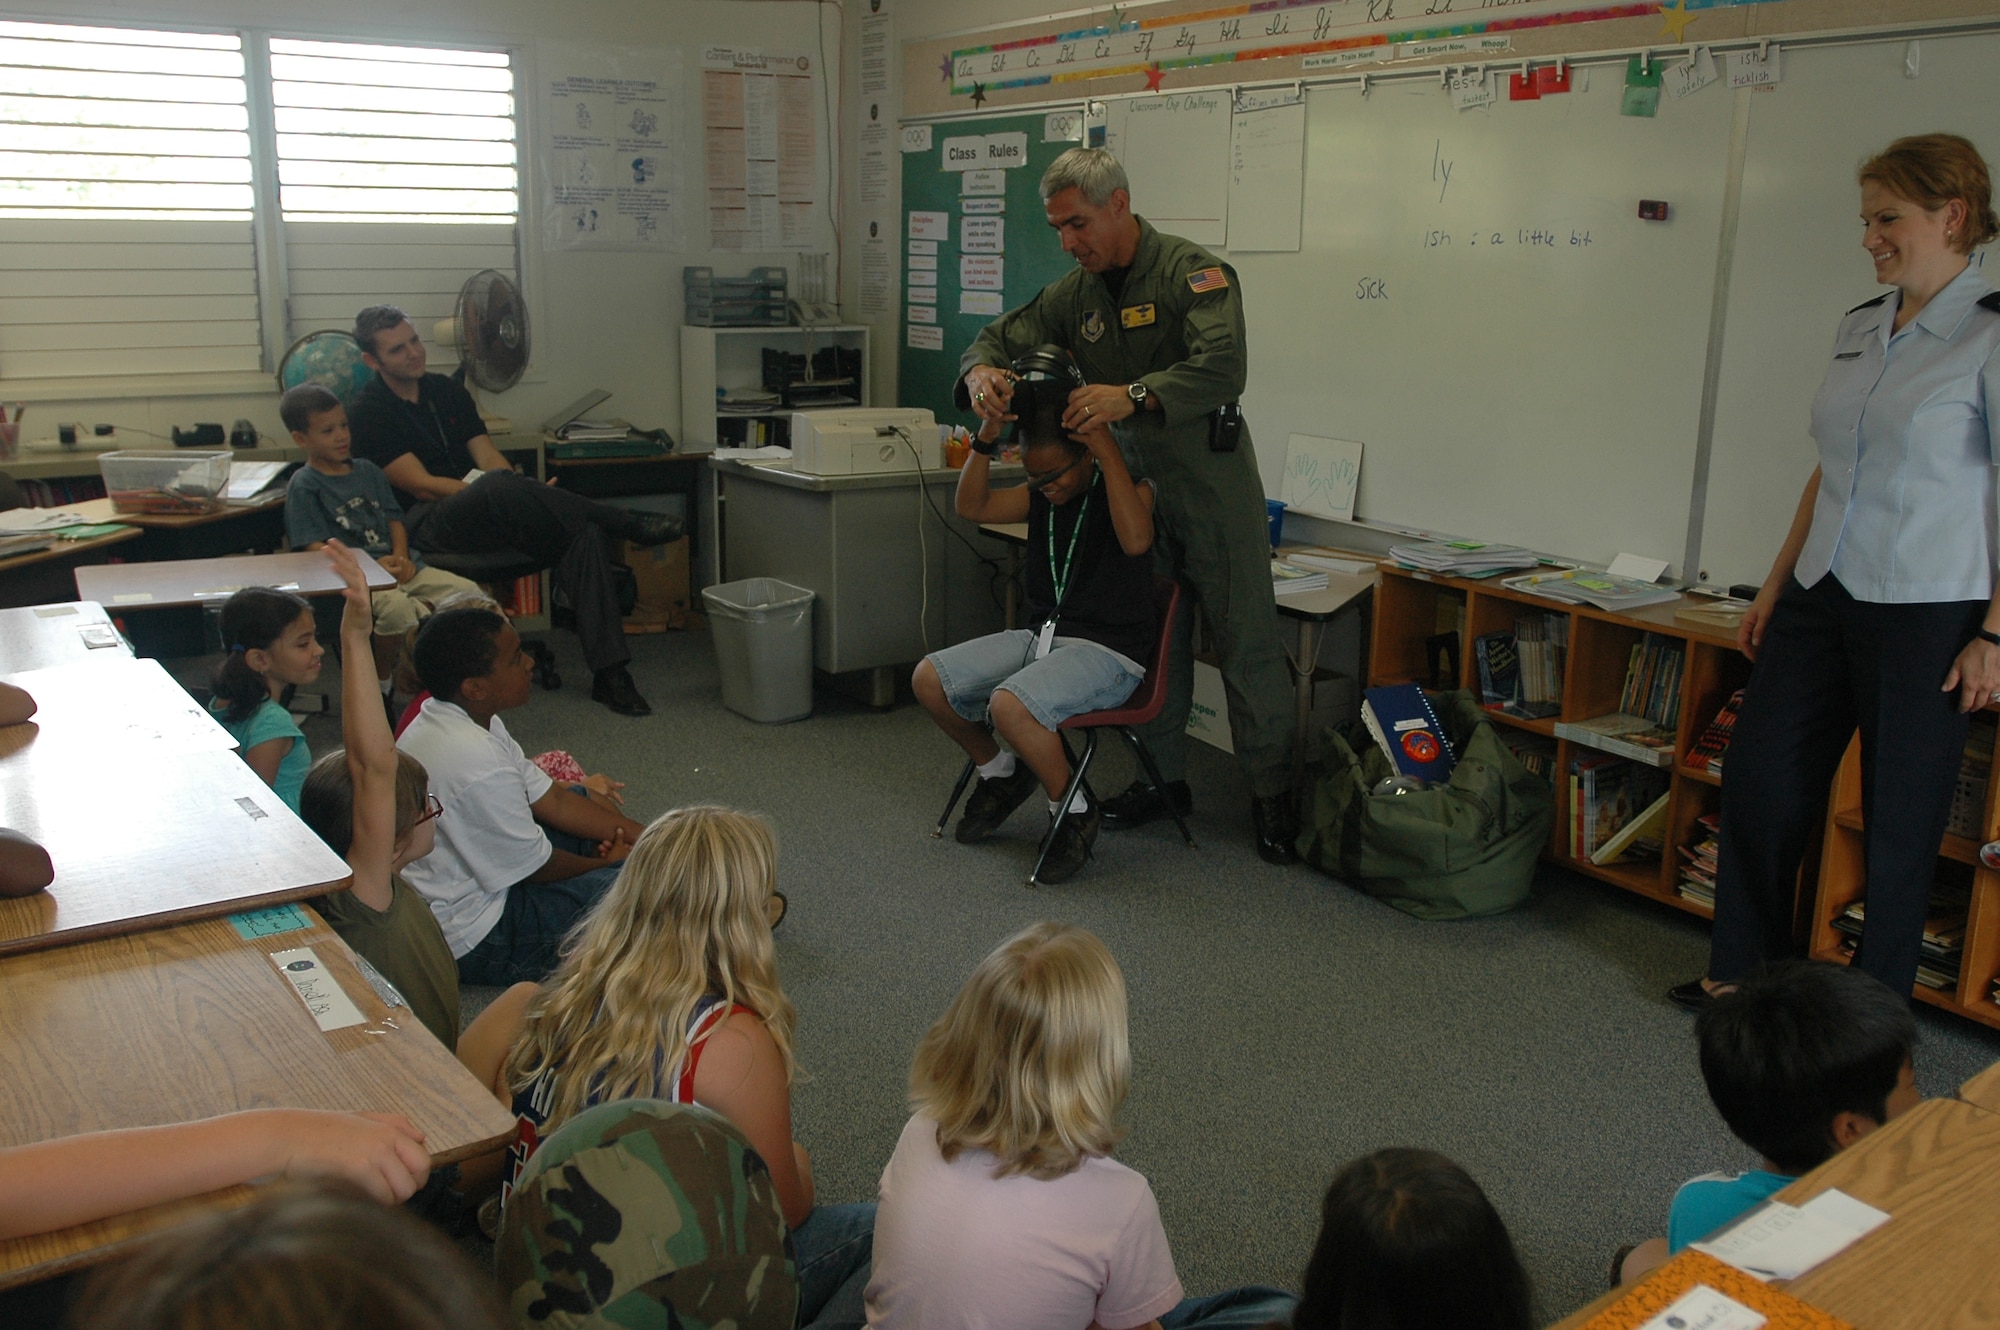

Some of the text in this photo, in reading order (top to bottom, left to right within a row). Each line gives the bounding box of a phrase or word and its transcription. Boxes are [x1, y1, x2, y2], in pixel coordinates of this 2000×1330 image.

[959, 59, 973, 77] Aa
[1026, 49, 1040, 68] Cc
[1056, 42, 1077, 64] Dd
[1095, 38, 1110, 59] Ee
[1219, 19, 1241, 42] Hh
[1312, 6, 1333, 40] Jj
[1412, 47, 1425, 56] Get
[1427, 45, 1446, 55] Smart
[1481, 39, 1508, 50] Whoop!
[1341, 53, 1357, 63] Train
[1741, 50, 1759, 65] ish
[1733, 71, 1769, 86] ticklish
[1676, 76, 1706, 99] safely
[949, 143, 1019, 160] Class Rules
[1433, 139, 1453, 203] ly
[1491, 232, 1504, 245] a
[1518, 230, 1555, 247] little
[1570, 230, 1593, 247] bit
